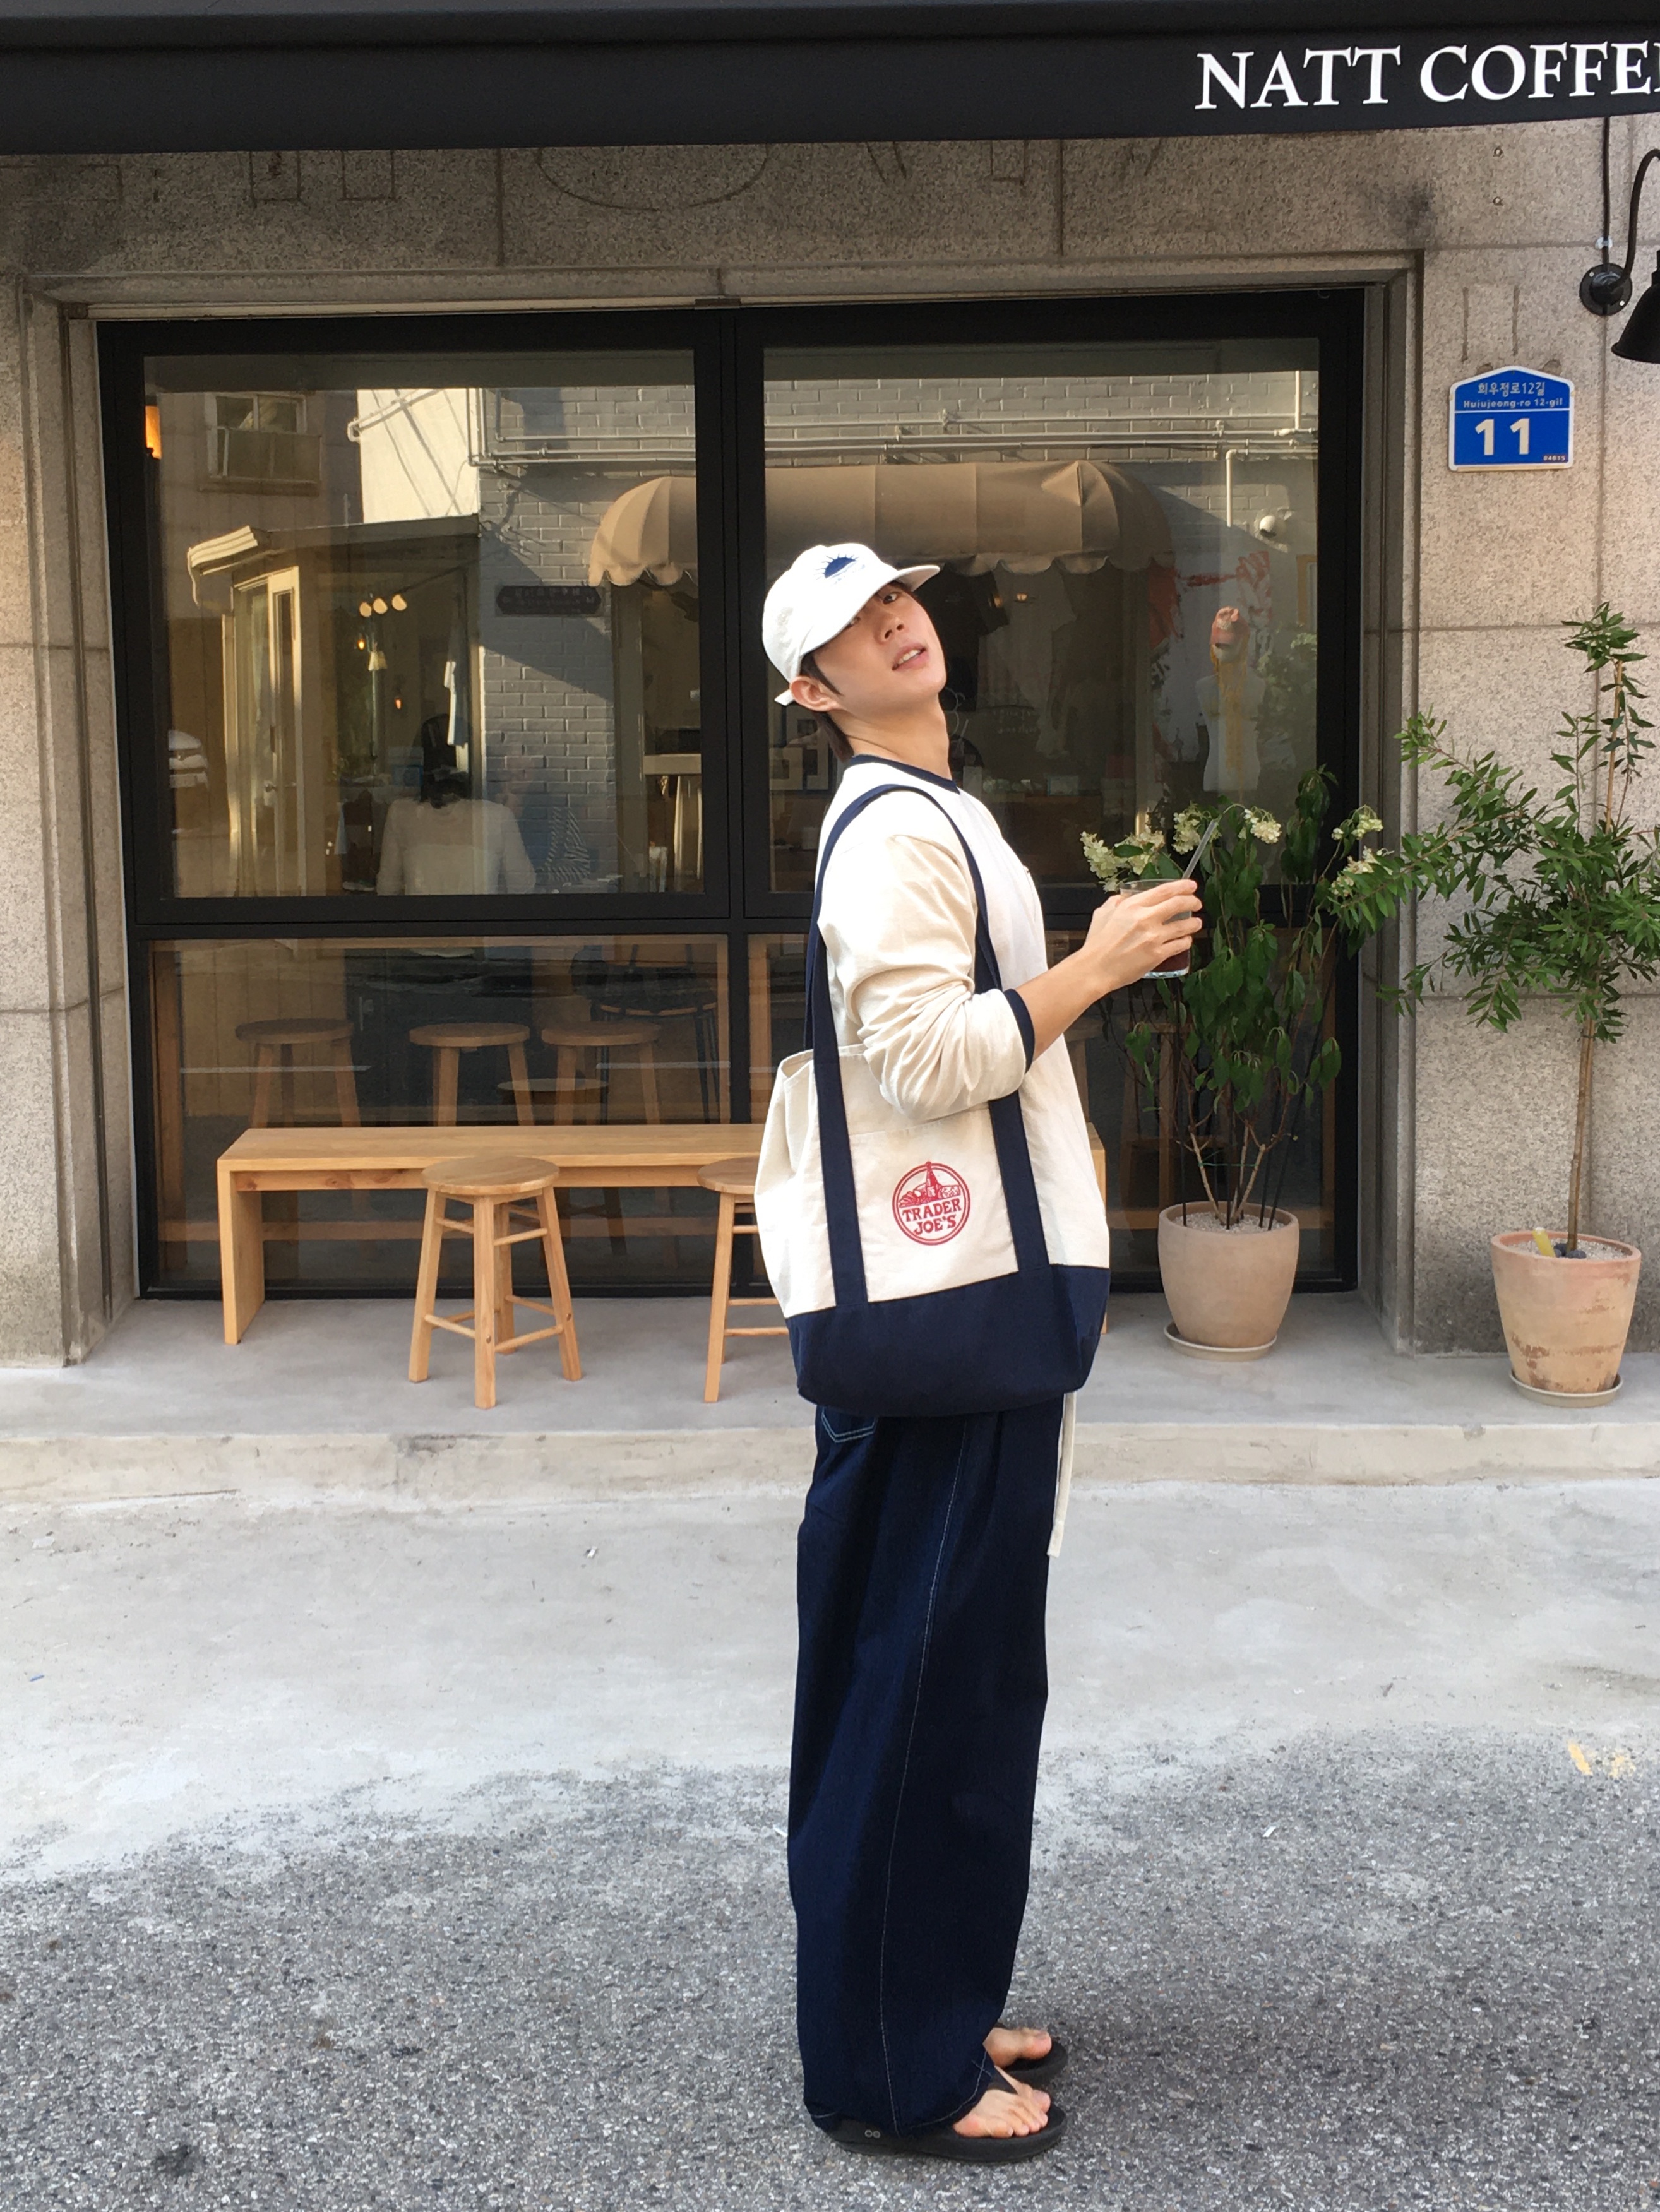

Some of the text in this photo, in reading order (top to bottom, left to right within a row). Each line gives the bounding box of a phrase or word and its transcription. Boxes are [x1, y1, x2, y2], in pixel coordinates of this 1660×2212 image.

[1195, 40, 1660, 109] NATT COFFE
[1478, 381, 1545, 398] 회우정로12길
[1463, 398, 1563, 409] Huiujeong-ro 12-gil
[1475, 418, 1530, 456] 11
[902, 1198, 962, 1222] TRADER
[913, 1214, 957, 1235] JOE'S
